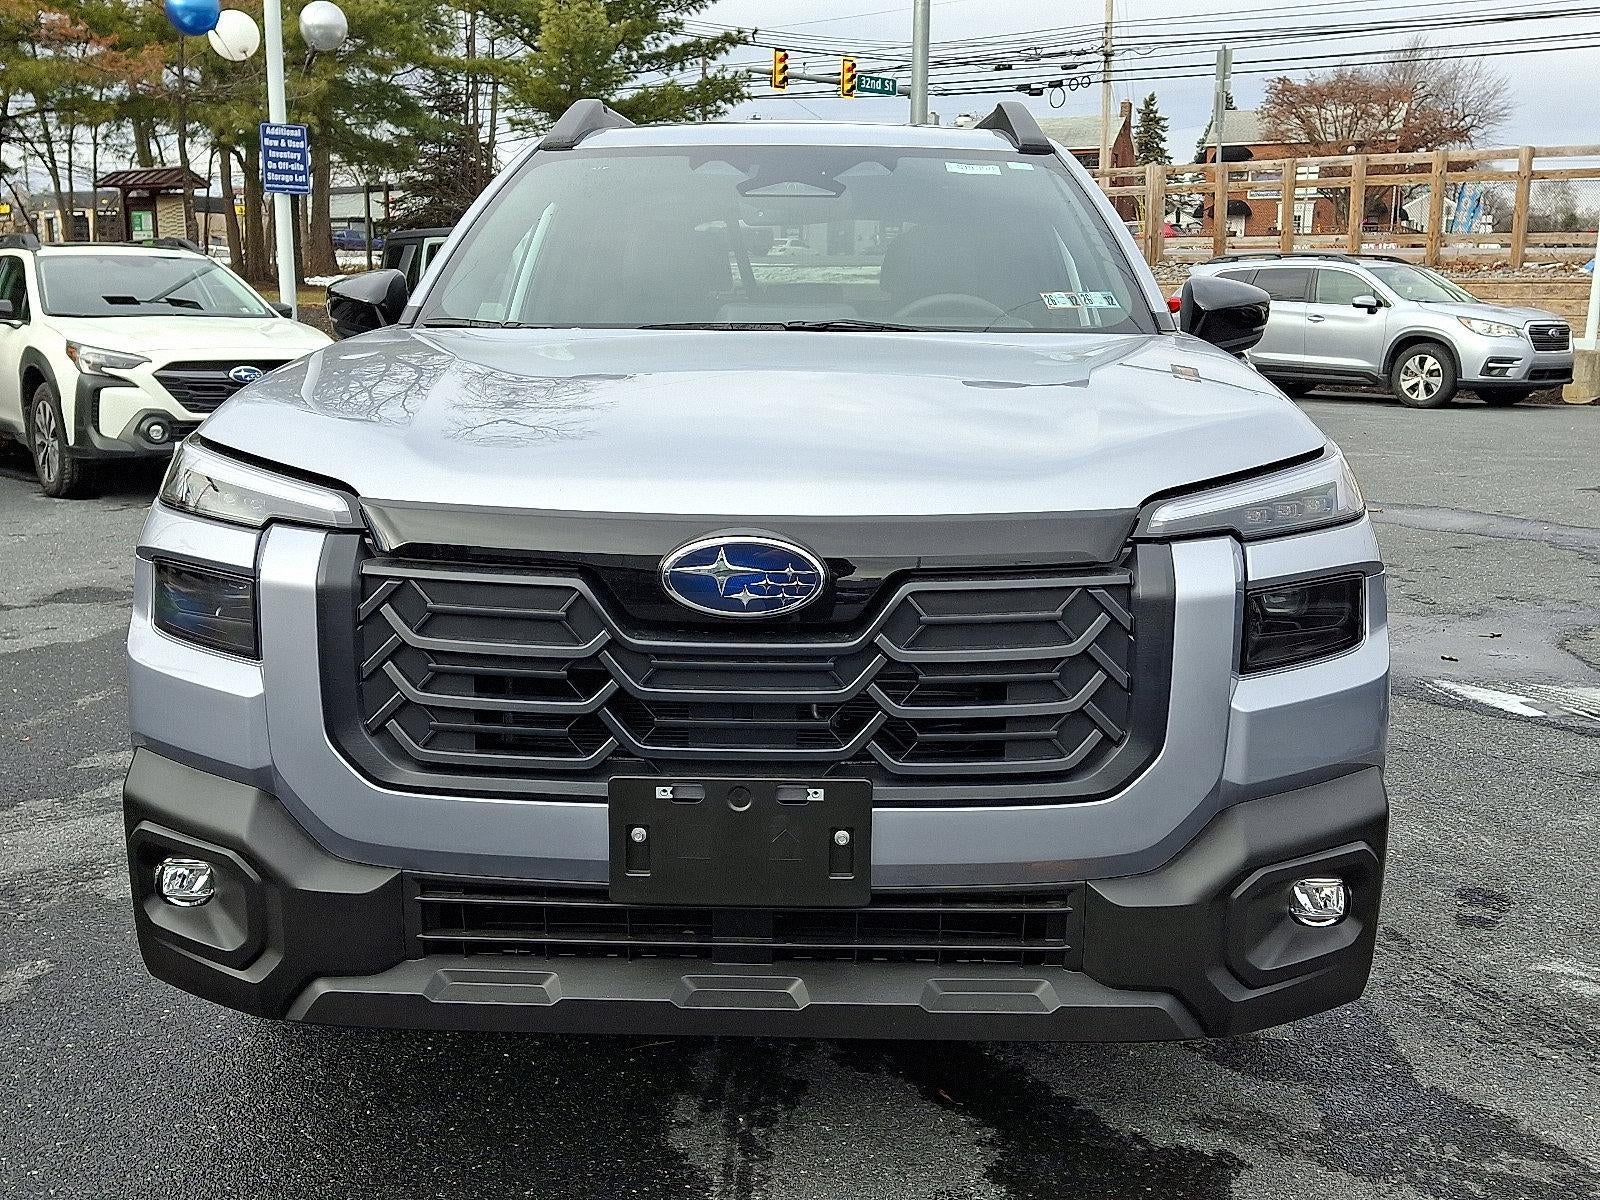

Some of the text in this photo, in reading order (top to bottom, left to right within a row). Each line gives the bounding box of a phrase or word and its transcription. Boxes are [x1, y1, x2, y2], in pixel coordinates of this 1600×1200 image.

[860, 76, 893, 92] 32nd St
[265, 126, 302, 137] Additional
[263, 137, 304, 149] New & Used
[268, 149, 302, 161] Inventory
[267, 160, 305, 171] On Off-site
[266, 172, 306, 183] Storage Lot
[1043, 294, 1080, 307] 26 12
[1080, 293, 1117, 306] 26 12
